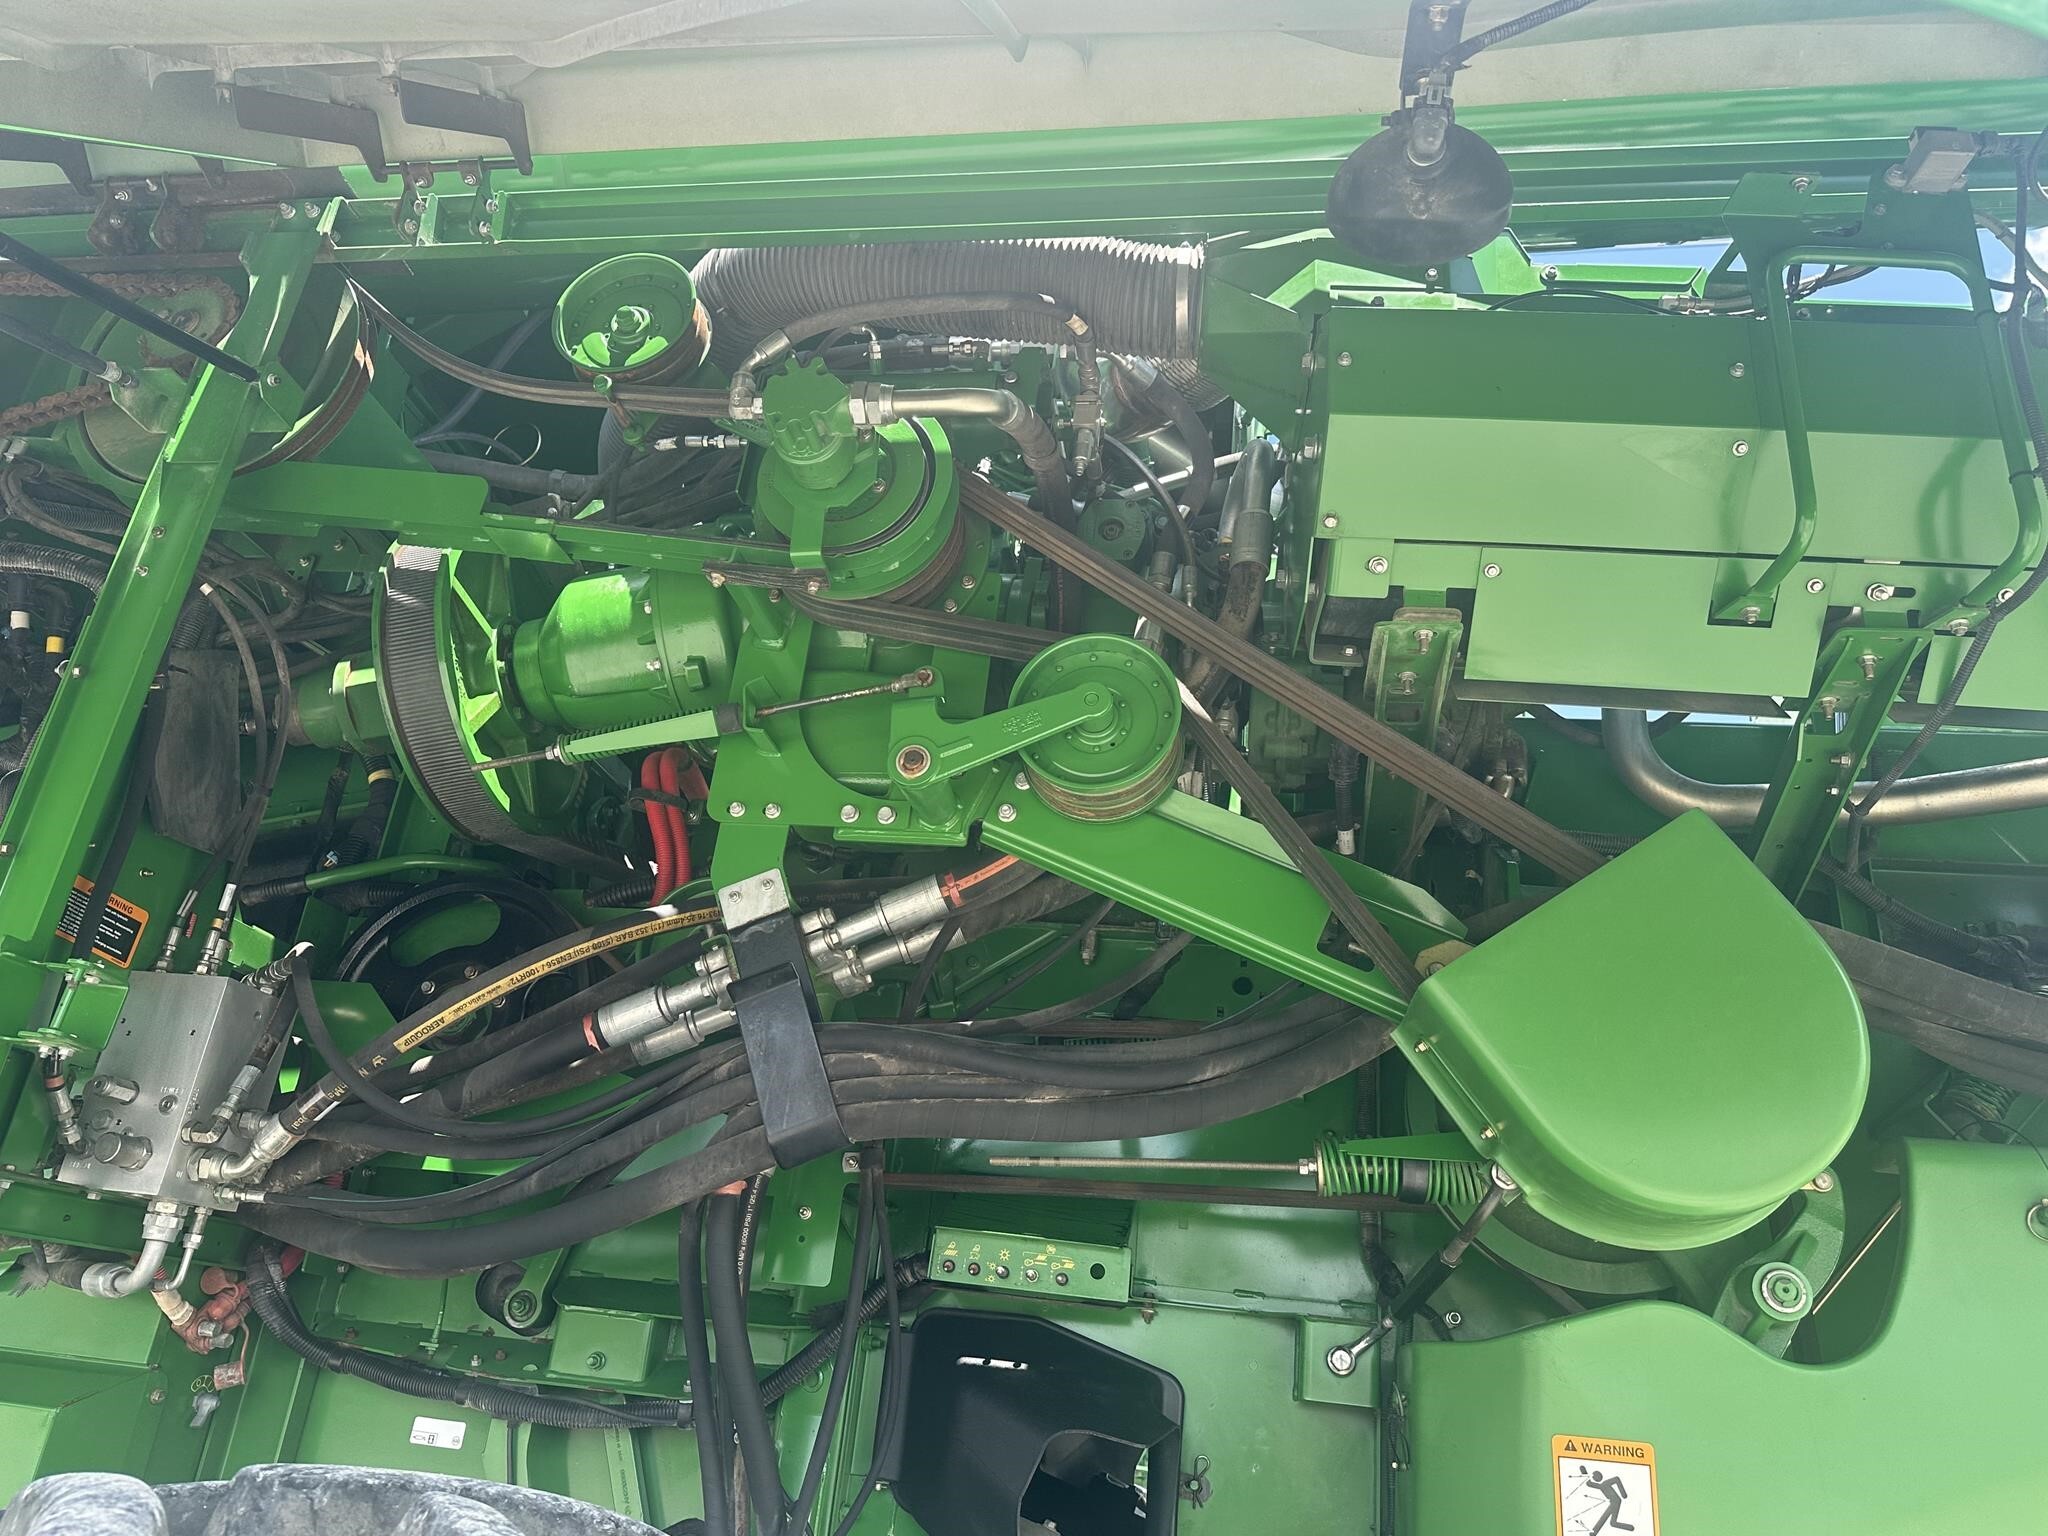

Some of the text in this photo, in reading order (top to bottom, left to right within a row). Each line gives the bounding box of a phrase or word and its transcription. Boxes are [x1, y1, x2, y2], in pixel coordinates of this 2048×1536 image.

[108, 896, 133, 915] RNING
[616, 931, 633, 942] BAR
[404, 1016, 446, 1047] AEROQUIP
[1581, 1442, 1645, 1459] WARNING
